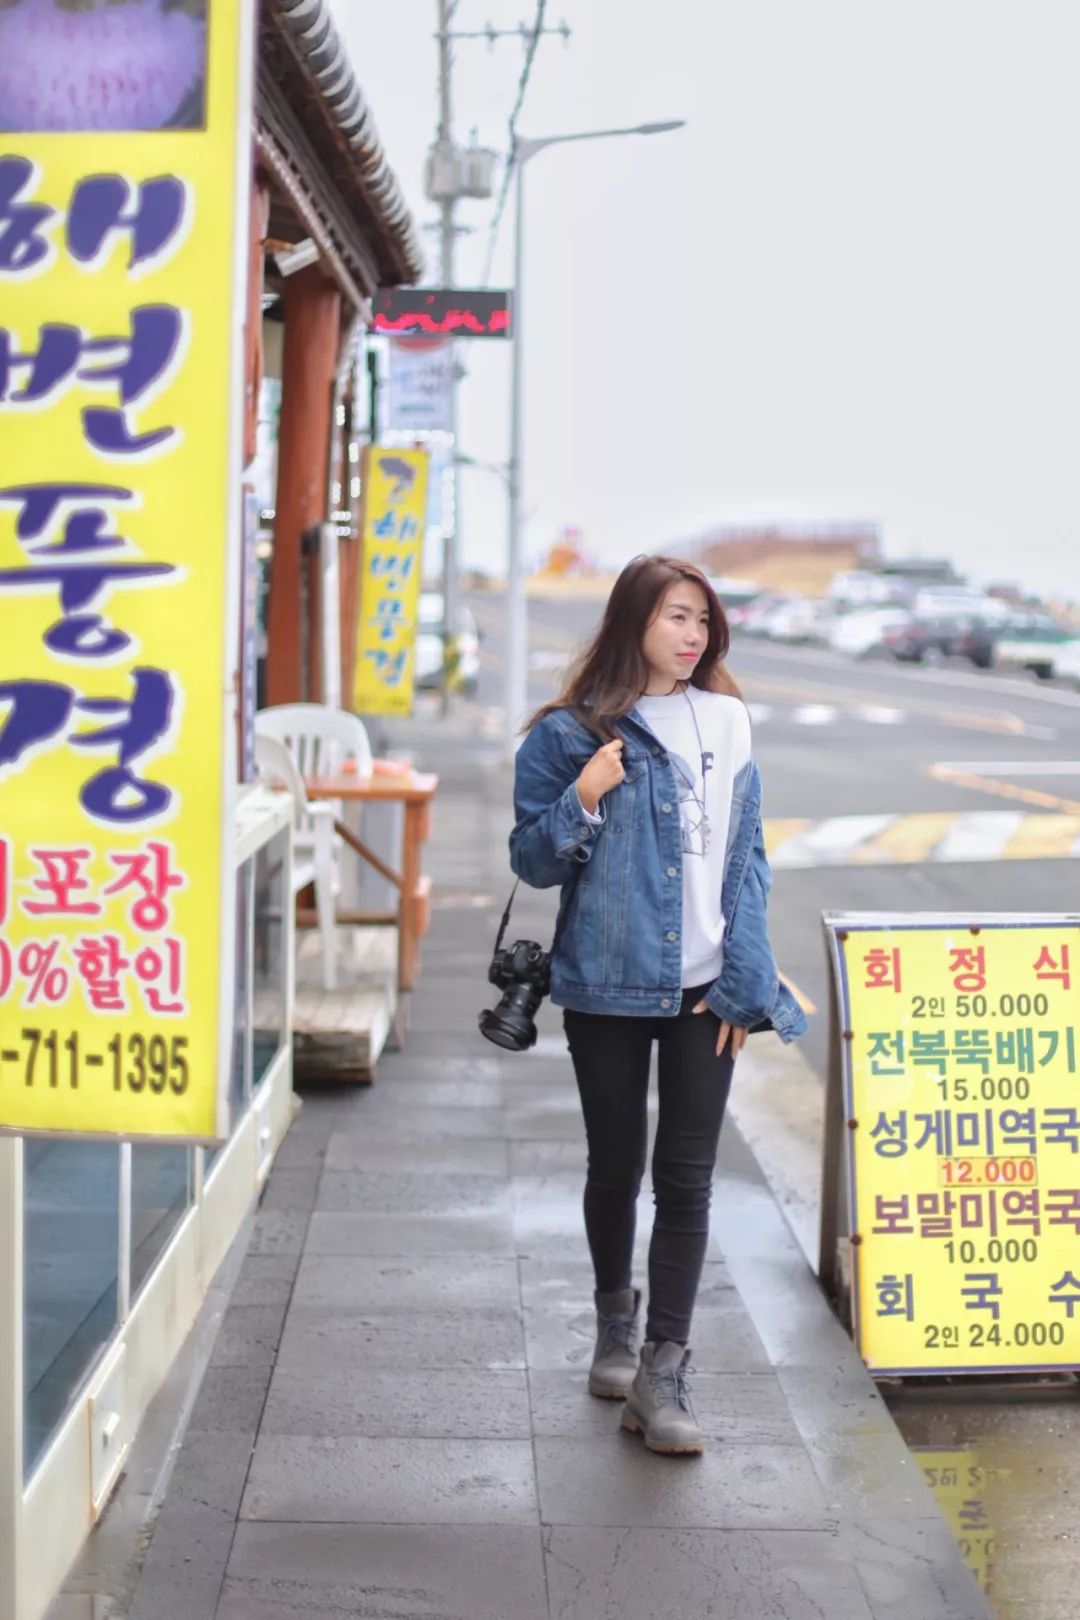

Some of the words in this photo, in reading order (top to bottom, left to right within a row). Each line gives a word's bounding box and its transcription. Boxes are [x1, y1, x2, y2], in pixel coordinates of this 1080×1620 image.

[0, 838, 183, 932] 포장
[911, 995, 945, 1018] 2인
[956, 993, 1048, 1017] 50.000
[867, 1027, 1075, 1075] 전복뚝배기
[937, 1077, 1030, 1101] 15.000
[870, 1108, 1080, 1158] 성게미역국
[941, 1160, 1035, 1183] 12.000
[872, 1189, 1080, 1238] 보말미역국
[944, 1239, 1038, 1264] 10.000
[924, 1325, 959, 1348] 2인
[969, 1322, 1064, 1347] 24.000
